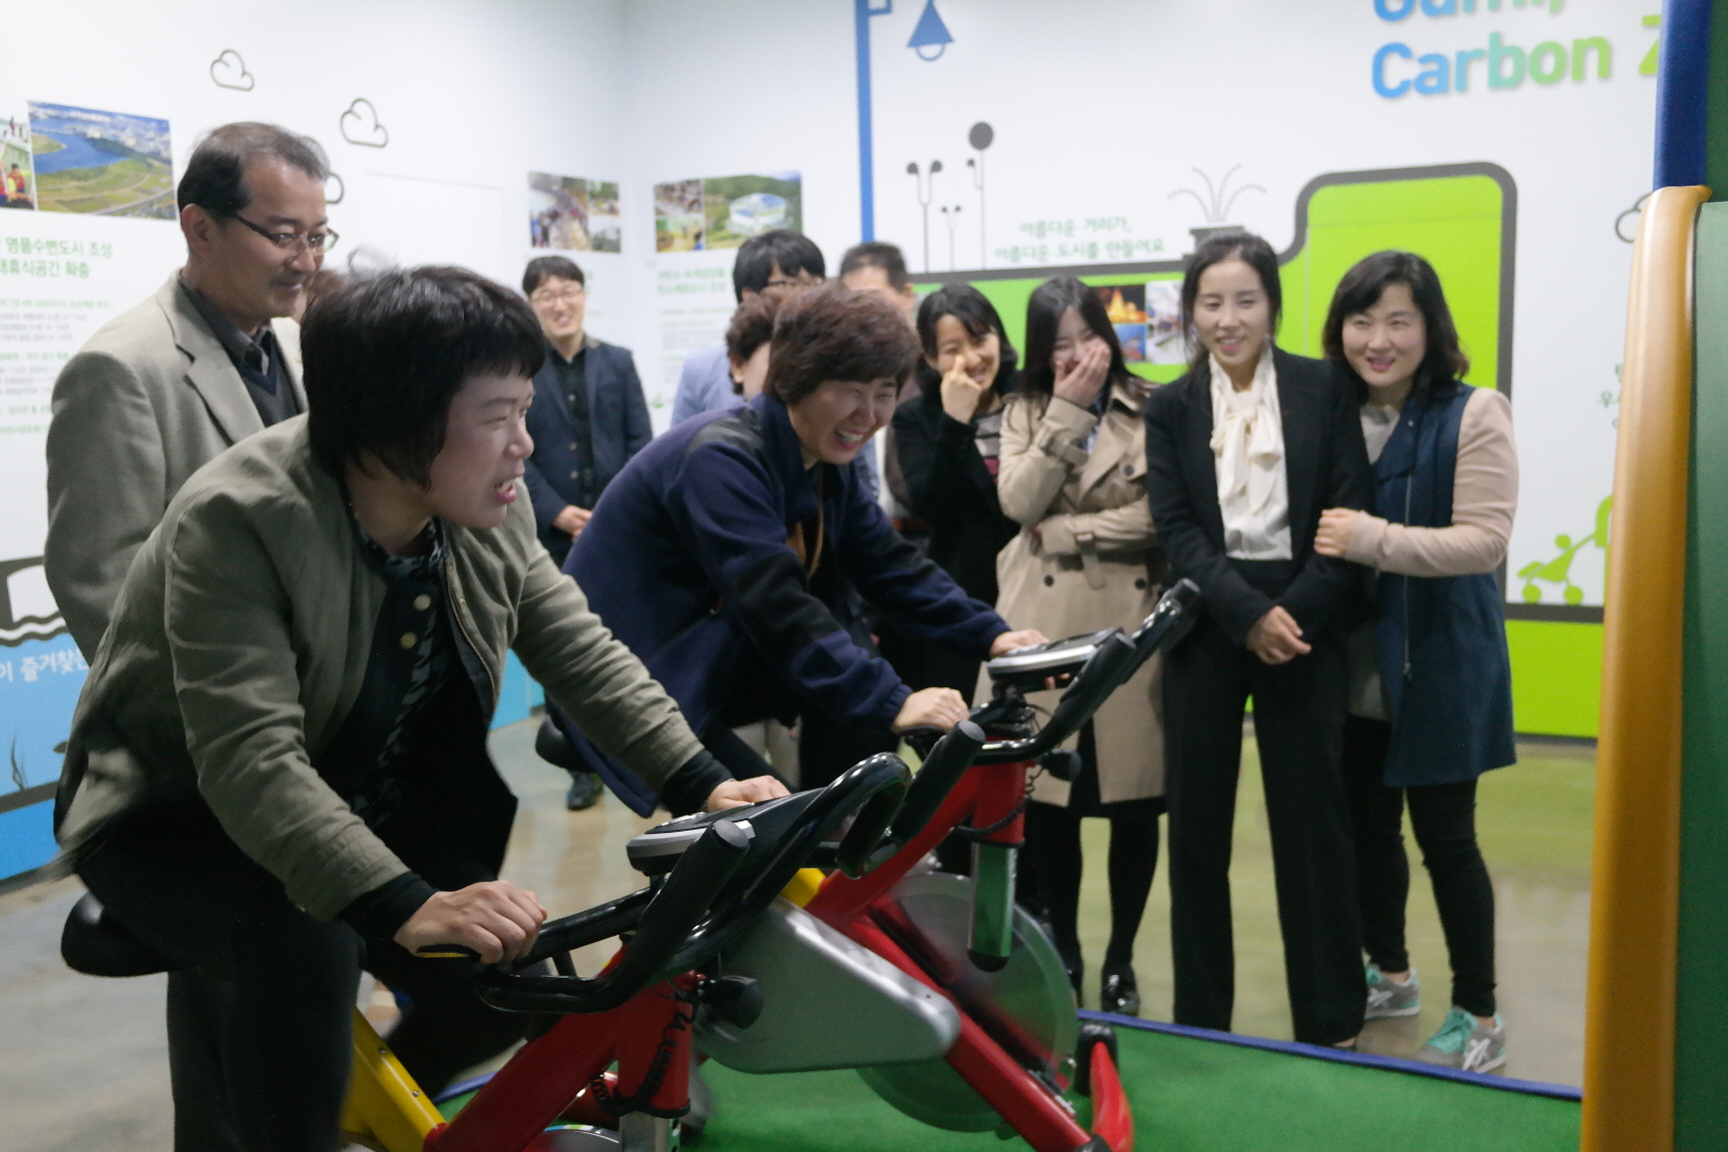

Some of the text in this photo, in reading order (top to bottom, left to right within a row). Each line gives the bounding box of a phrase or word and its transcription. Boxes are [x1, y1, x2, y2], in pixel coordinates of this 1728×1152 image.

[1371, 31, 1612, 99] Carbon
[1019, 219, 1075, 239] 아름다운
[6, 236, 113, 259] 명품수변도시 조성
[1057, 241, 1098, 260] 도시를
